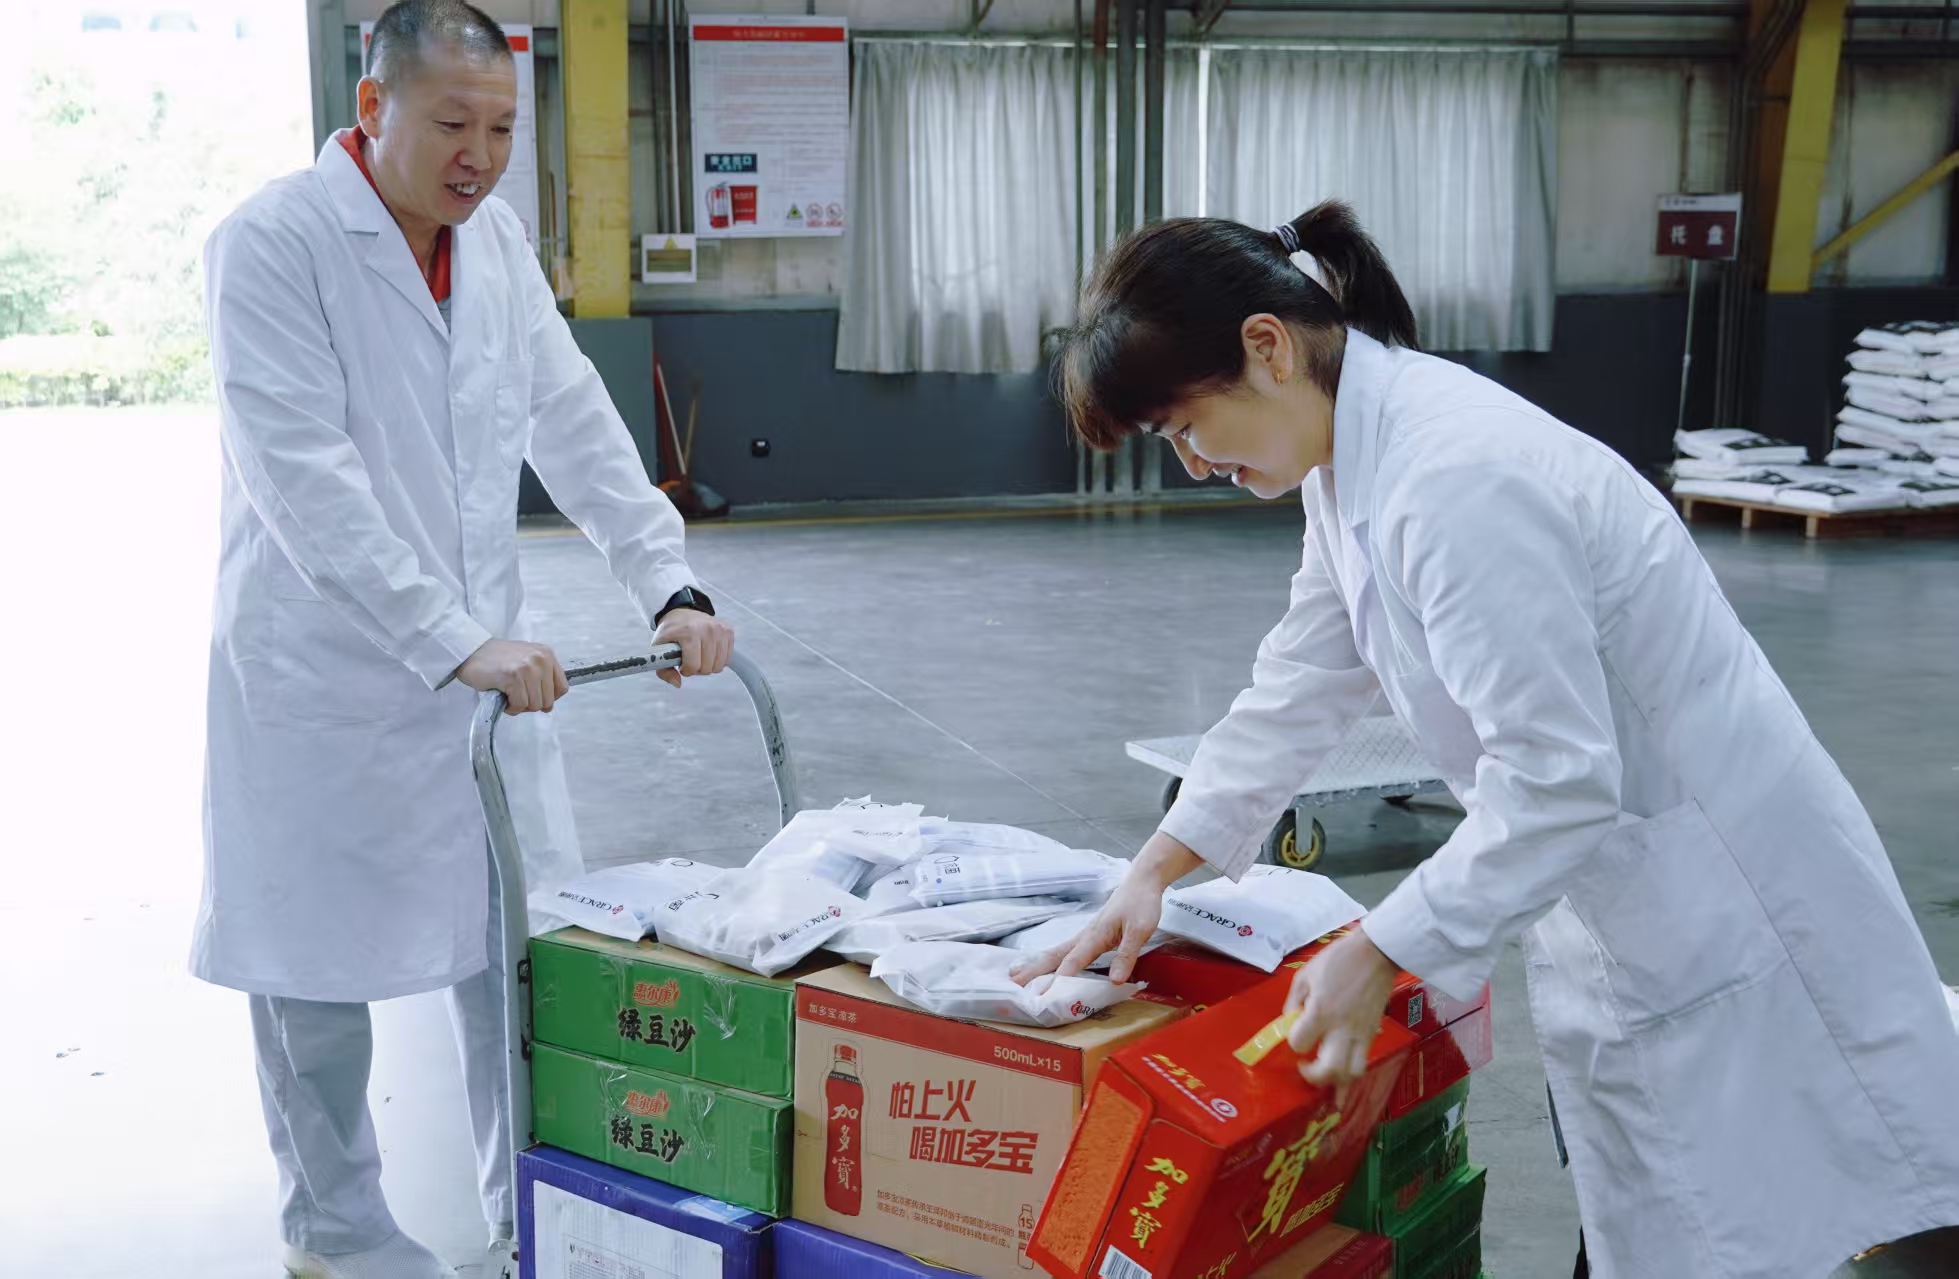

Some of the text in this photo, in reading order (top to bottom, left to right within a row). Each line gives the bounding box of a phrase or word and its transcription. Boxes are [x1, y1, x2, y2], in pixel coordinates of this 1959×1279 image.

[1193, 907, 1236, 929] GRACE
[617, 1007, 697, 1053] 绿豆沙
[808, 1003, 858, 1024] 加多宝凉茶
[888, 1079, 977, 1123] 怕上火
[611, 1114, 685, 1163] 绿豆沙
[909, 1126, 1039, 1175] 喝加多宝
[1020, 1217, 1034, 1229] 15
